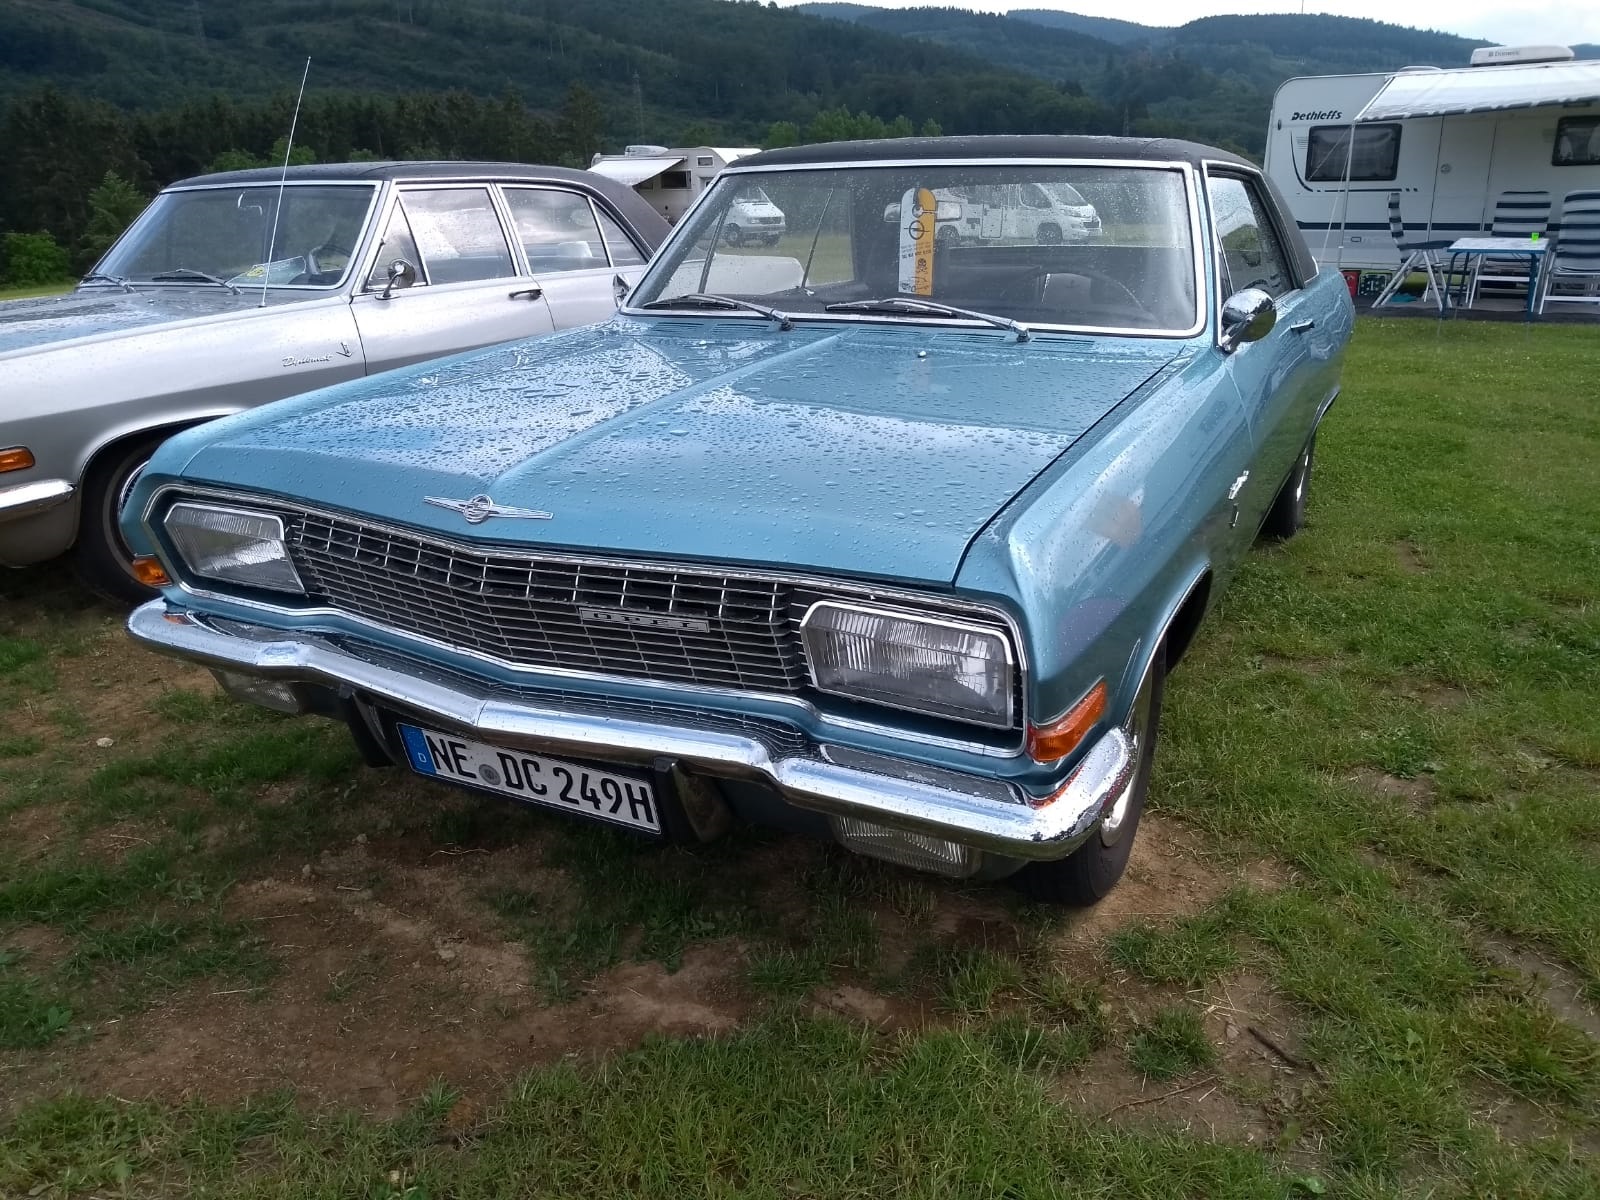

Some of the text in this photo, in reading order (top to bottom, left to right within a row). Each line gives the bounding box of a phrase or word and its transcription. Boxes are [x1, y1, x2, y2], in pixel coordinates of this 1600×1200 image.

[1291, 110, 1342, 121] Dethleffs
[425, 735, 653, 823] NE DC 249H
